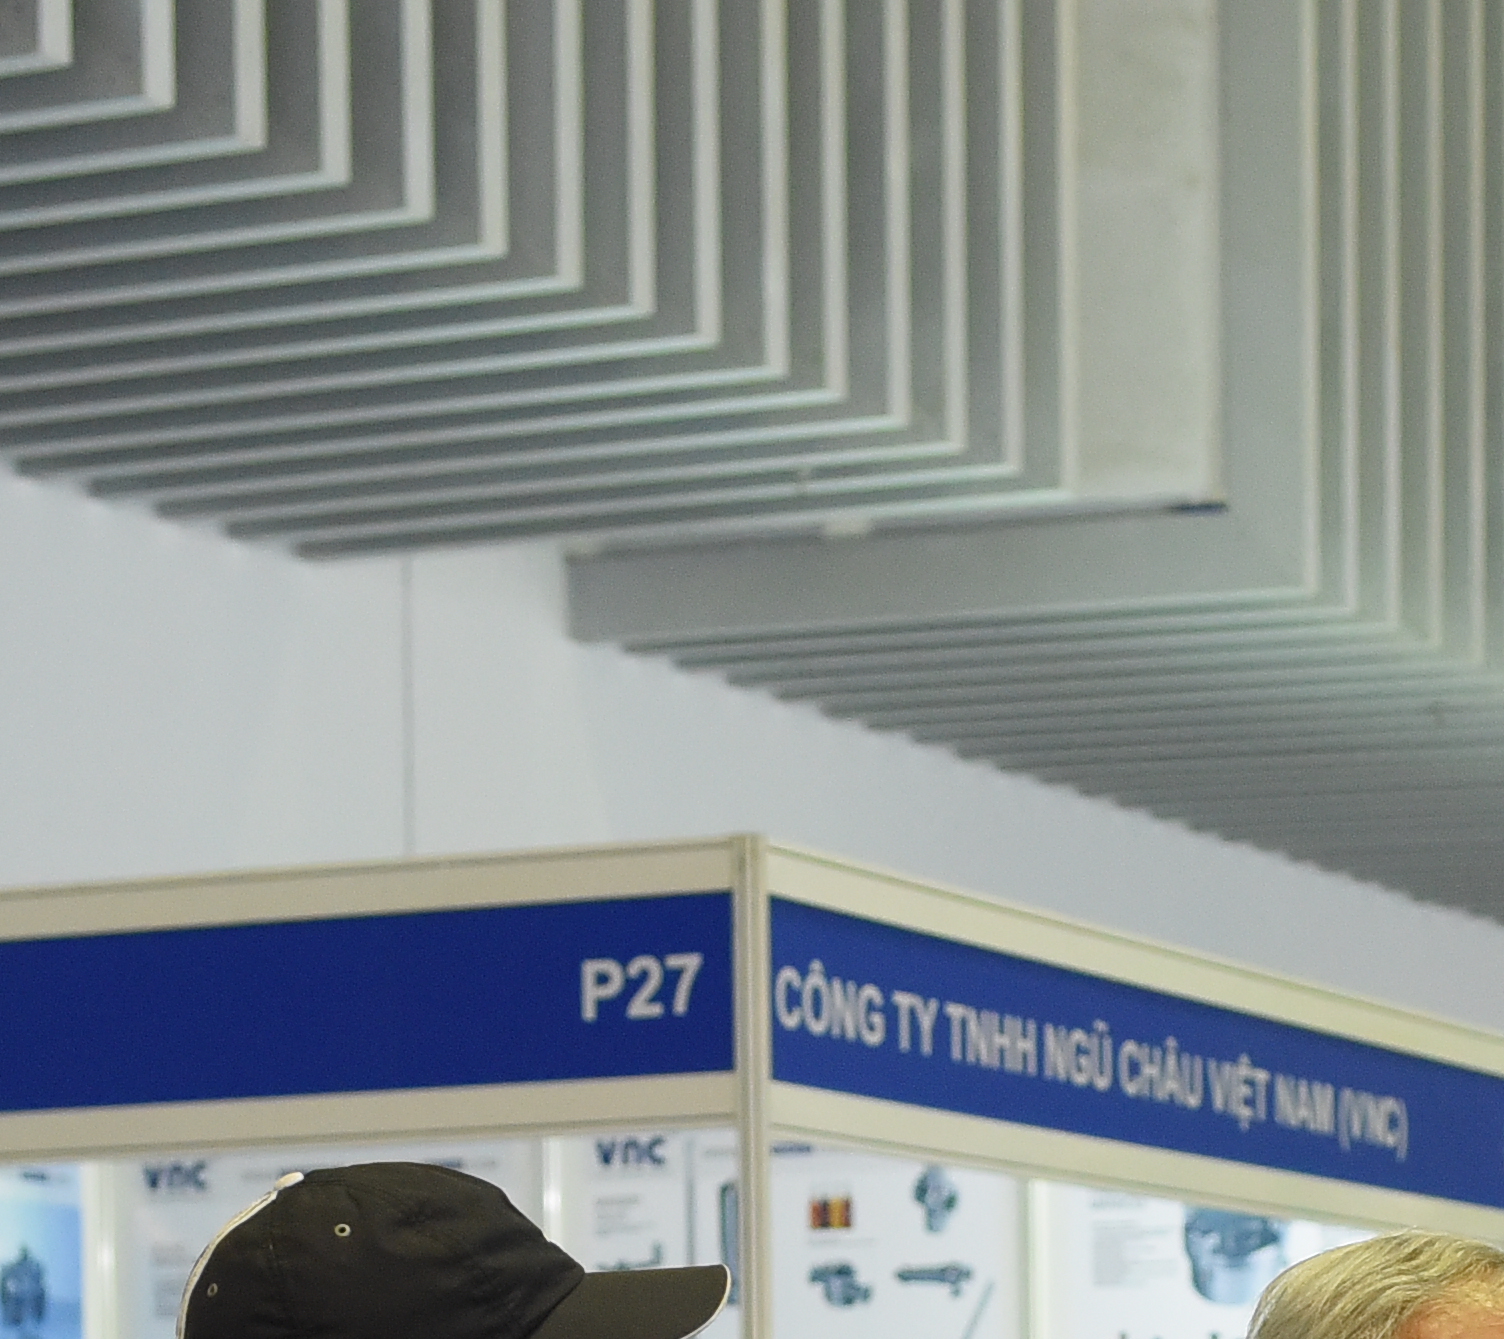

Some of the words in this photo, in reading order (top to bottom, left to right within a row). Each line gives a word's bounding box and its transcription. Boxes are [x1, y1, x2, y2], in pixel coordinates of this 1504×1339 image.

[580, 952, 704, 1023] P27
[774, 958, 886, 1047] CÔNG
[892, 990, 939, 1056] TY
[945, 1002, 1038, 1077] TNHH
[1043, 1019, 1113, 1092] NGŨ
[1119, 1036, 1203, 1109] CHÂU
[1208, 1052, 1271, 1132] VIỆT
[1274, 1072, 1336, 1137] NAM
